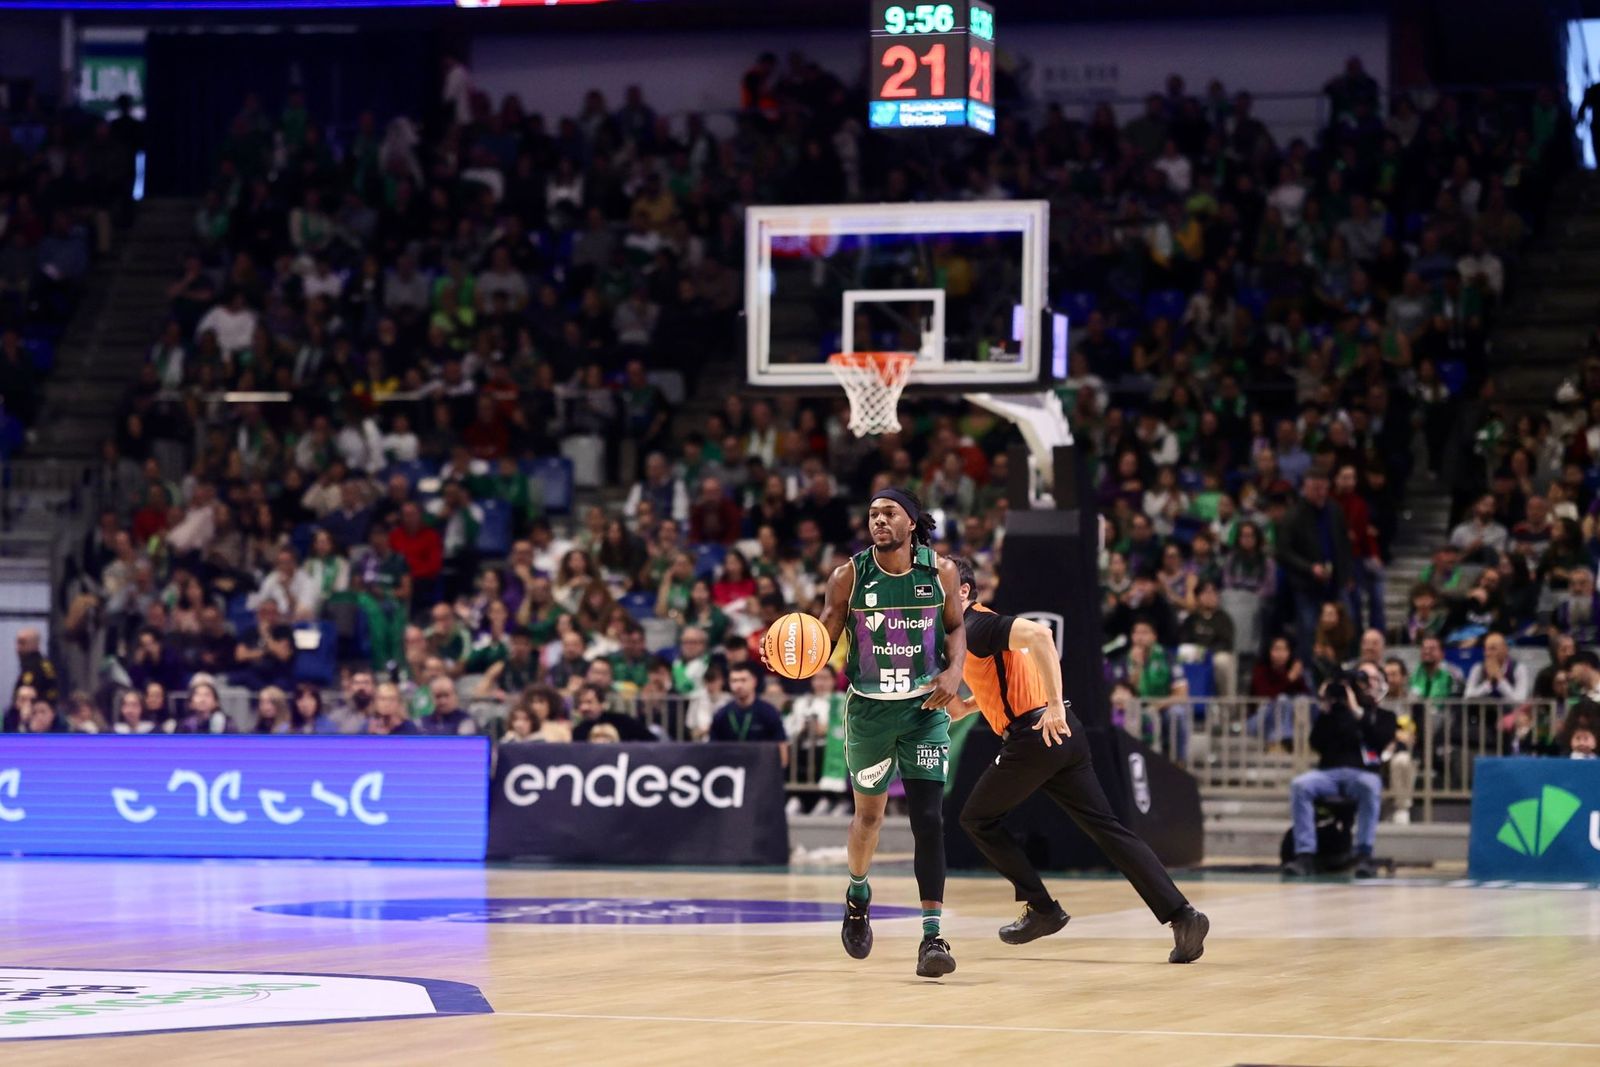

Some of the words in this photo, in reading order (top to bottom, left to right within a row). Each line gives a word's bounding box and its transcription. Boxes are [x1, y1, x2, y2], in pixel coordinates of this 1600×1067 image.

[885, 4, 954, 34] 9:56
[79, 66, 142, 101] LIDA
[880, 44, 945, 97] 21
[969, 46, 990, 103] 21
[887, 616, 934, 631] Unicaja
[784, 622, 797, 666] Wilson
[872, 641, 922, 658] málaga
[880, 668, 911, 693] 55
[917, 755, 940, 769] laga
[920, 746, 940, 758] má
[503, 752, 746, 808] endesa
